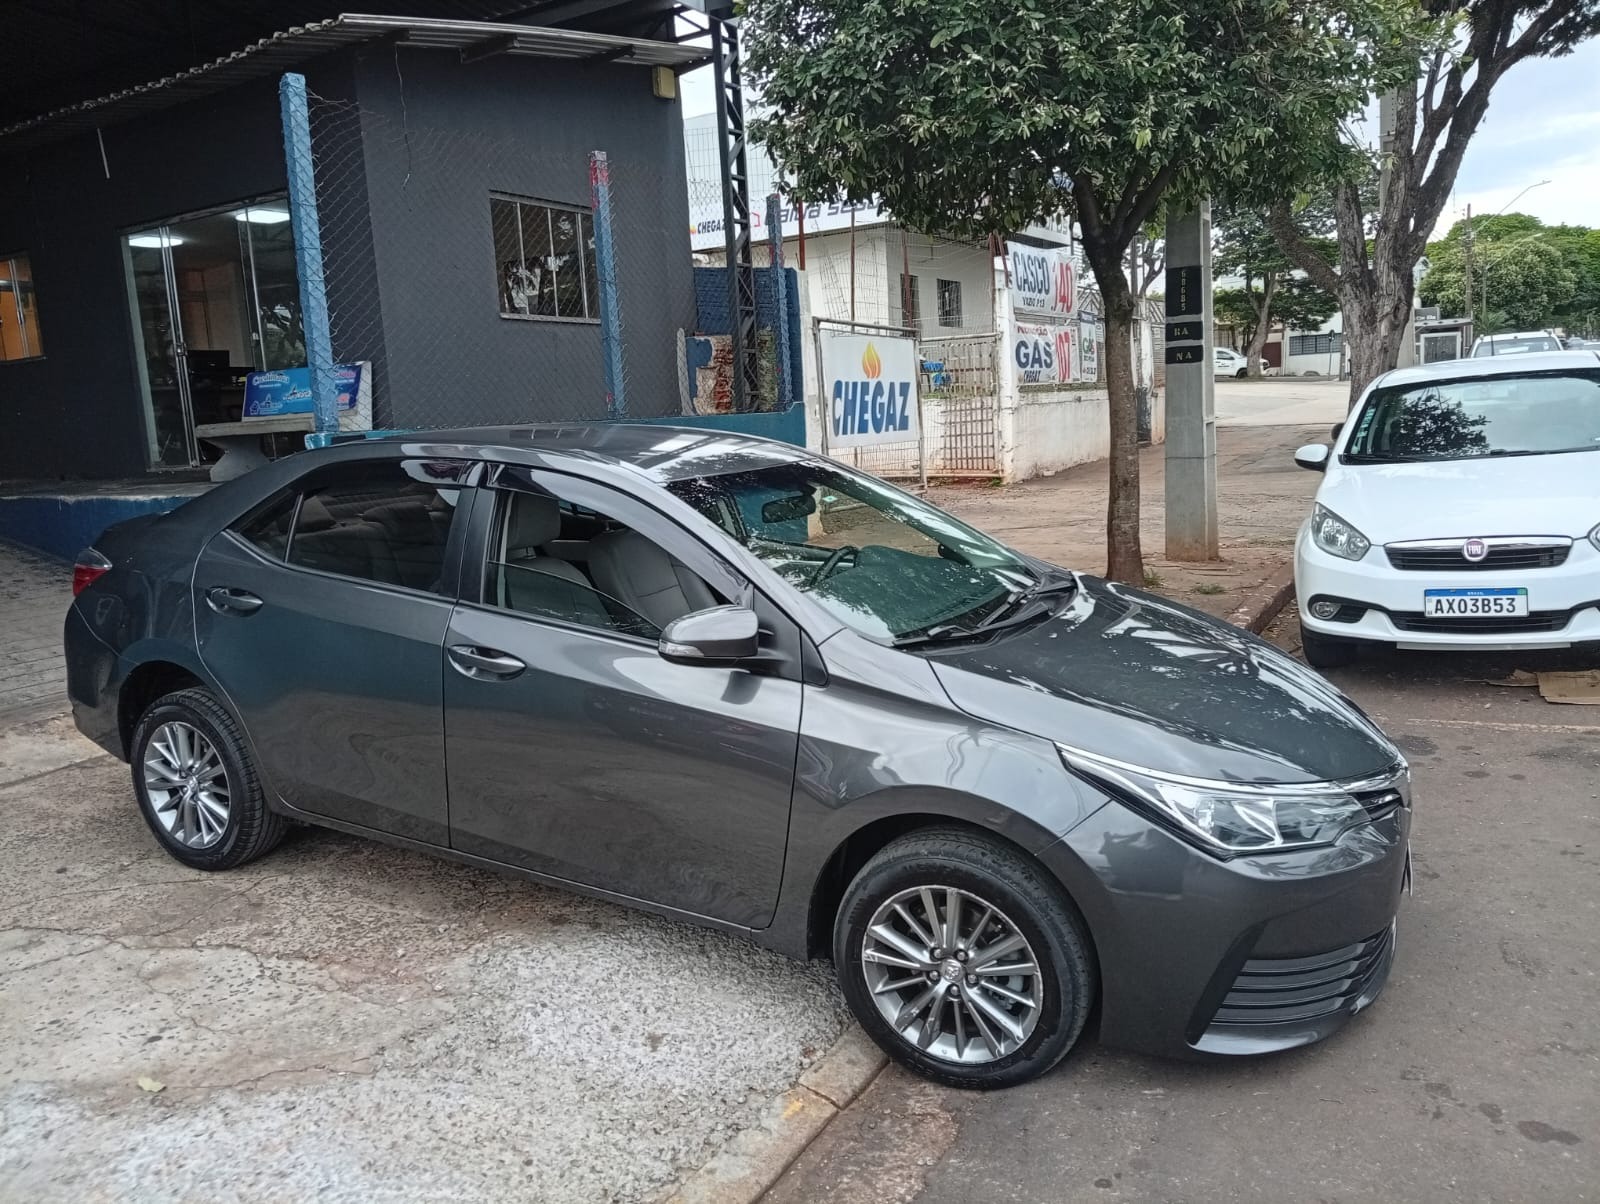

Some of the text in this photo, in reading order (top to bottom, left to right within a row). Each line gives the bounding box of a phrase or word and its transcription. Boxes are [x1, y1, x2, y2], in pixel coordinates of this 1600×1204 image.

[1013, 251, 1050, 295] CASCO
[832, 379, 911, 437] CHEGAZ
[1467, 544, 1482, 555] FIAT
